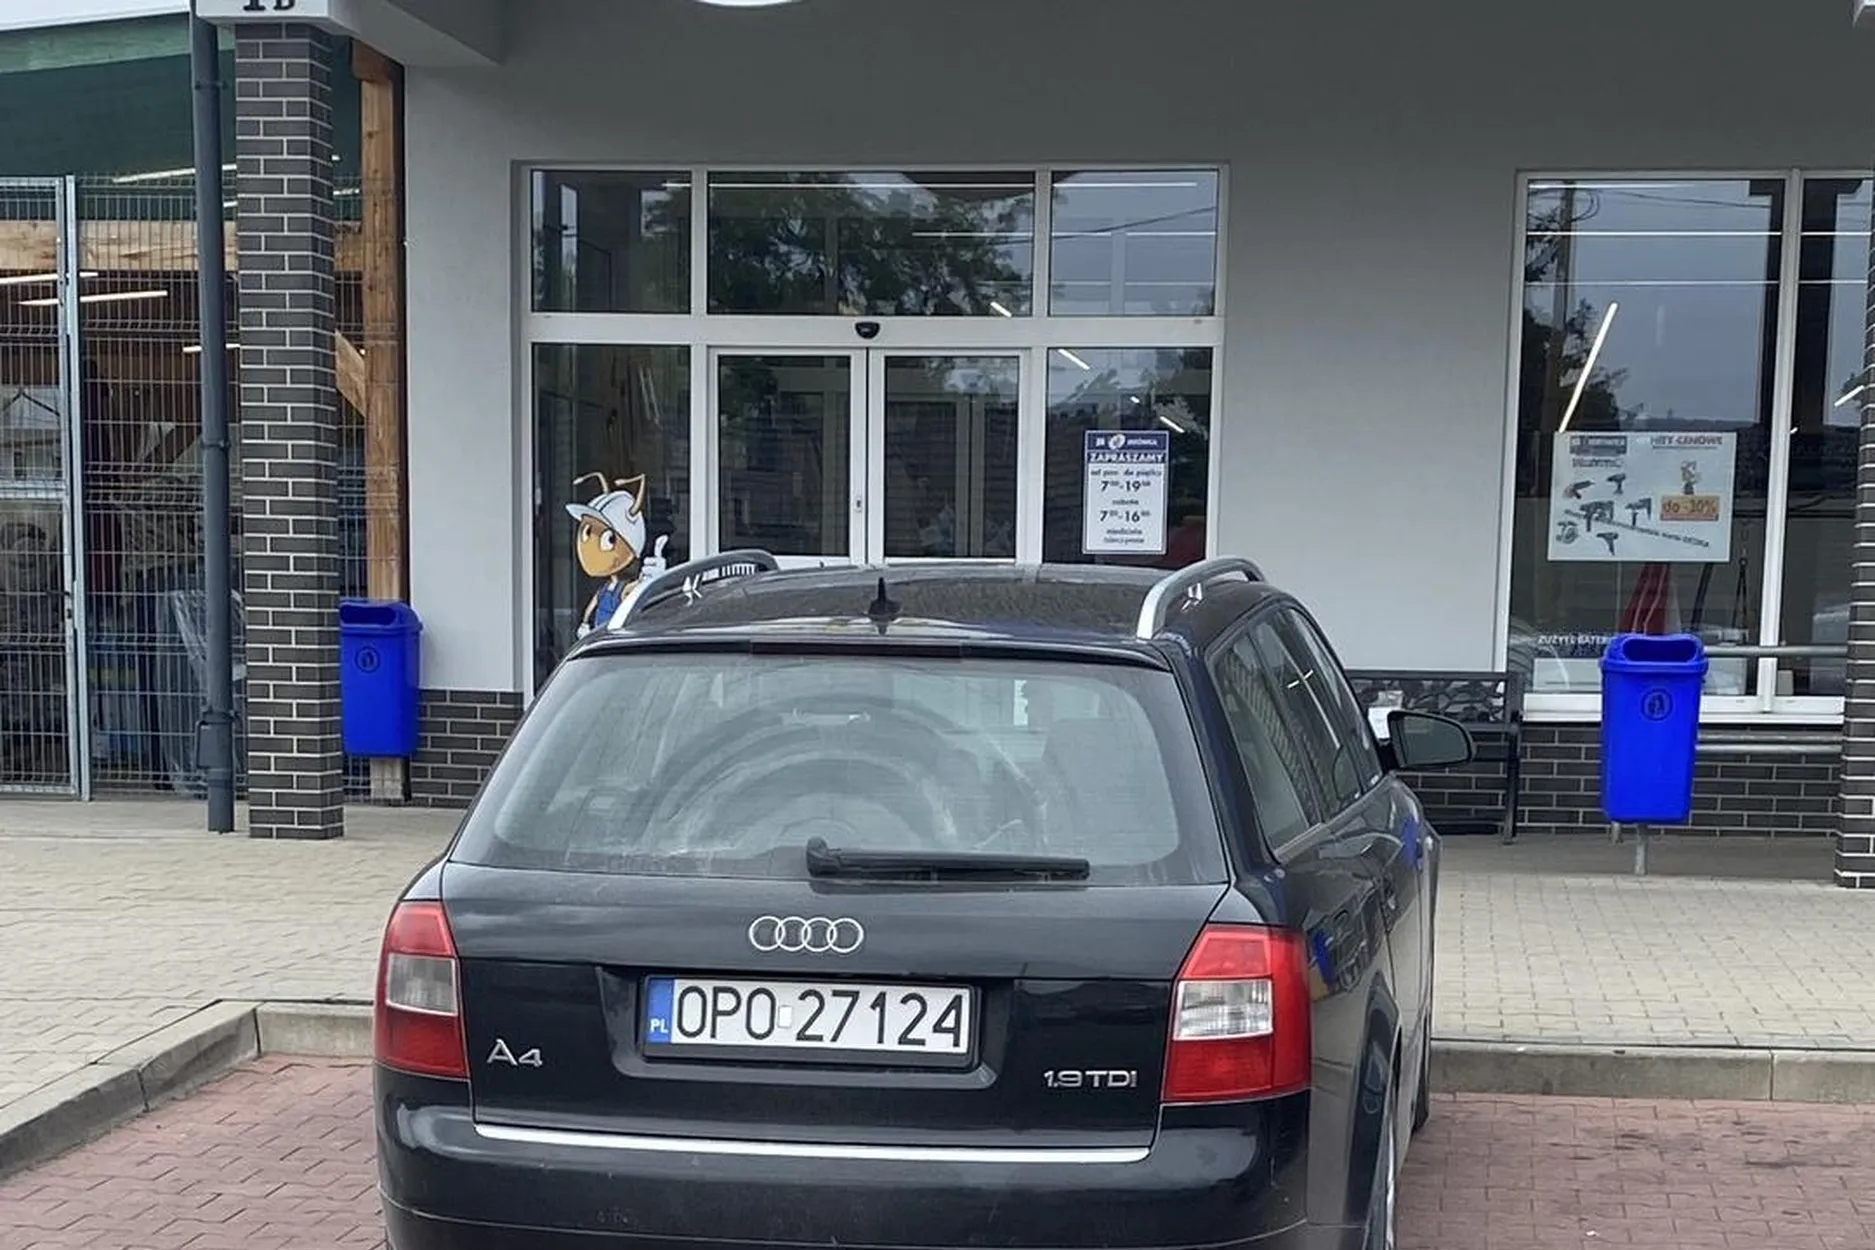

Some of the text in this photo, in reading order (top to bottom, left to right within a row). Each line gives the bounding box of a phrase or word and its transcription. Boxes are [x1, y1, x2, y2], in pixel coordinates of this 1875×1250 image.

[1090, 452, 1163, 461] ZAPRASZAMY
[650, 1019, 669, 1034] PL
[677, 985, 970, 1048] OPO 27124
[486, 1038, 543, 1067] A4
